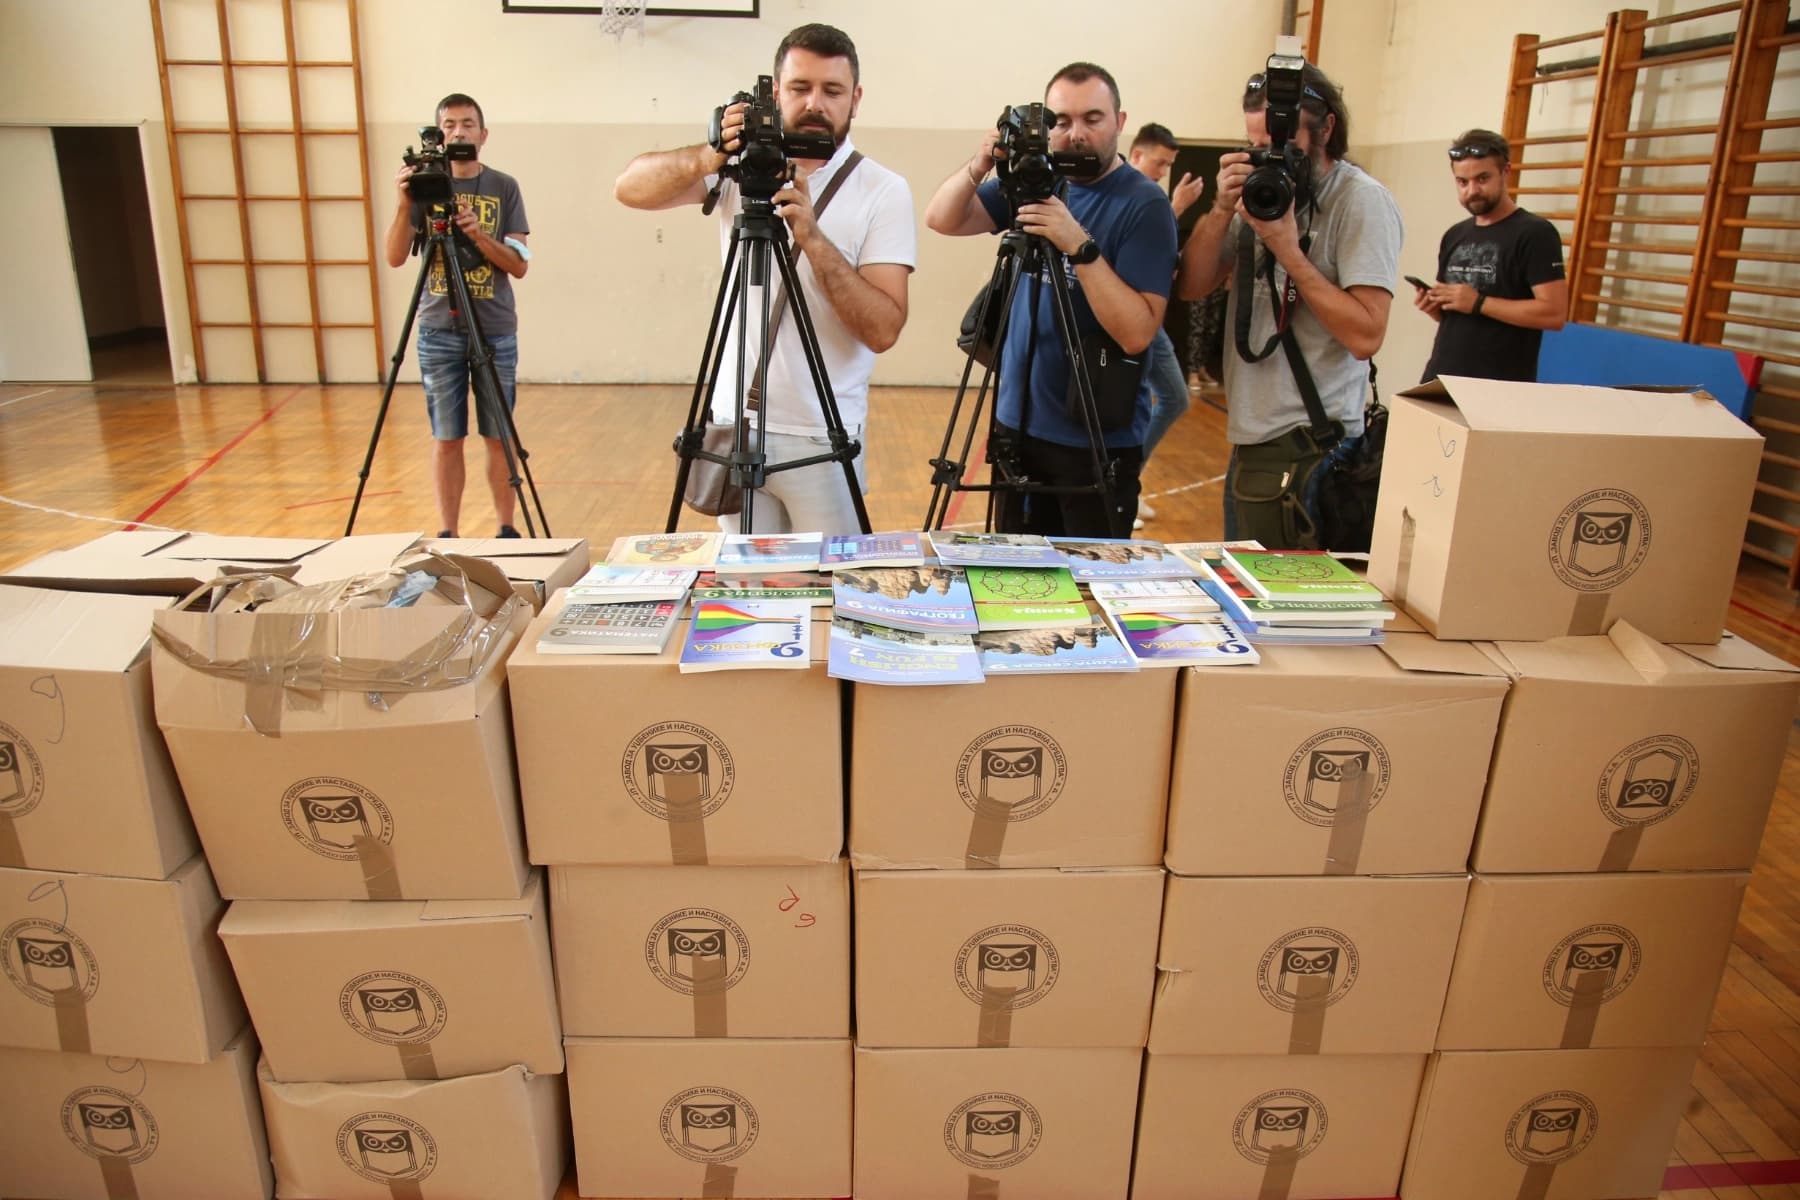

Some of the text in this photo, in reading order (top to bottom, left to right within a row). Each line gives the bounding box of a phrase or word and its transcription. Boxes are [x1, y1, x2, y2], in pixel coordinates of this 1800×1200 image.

[703, 590, 720, 598] 9
[846, 600, 864, 610] 9
[1256, 600, 1275, 610] 9
[549, 627, 658, 638] МАТЕМАТИКА 9
[769, 641, 804, 658] 9
[1215, 640, 1250, 655] 9
[625, 747, 635, 758] ЗА
[673, 722, 715, 742] НАСТАВНА
[961, 752, 971, 762] ЗА
[1012, 727, 1051, 744] НАСТАВНА
